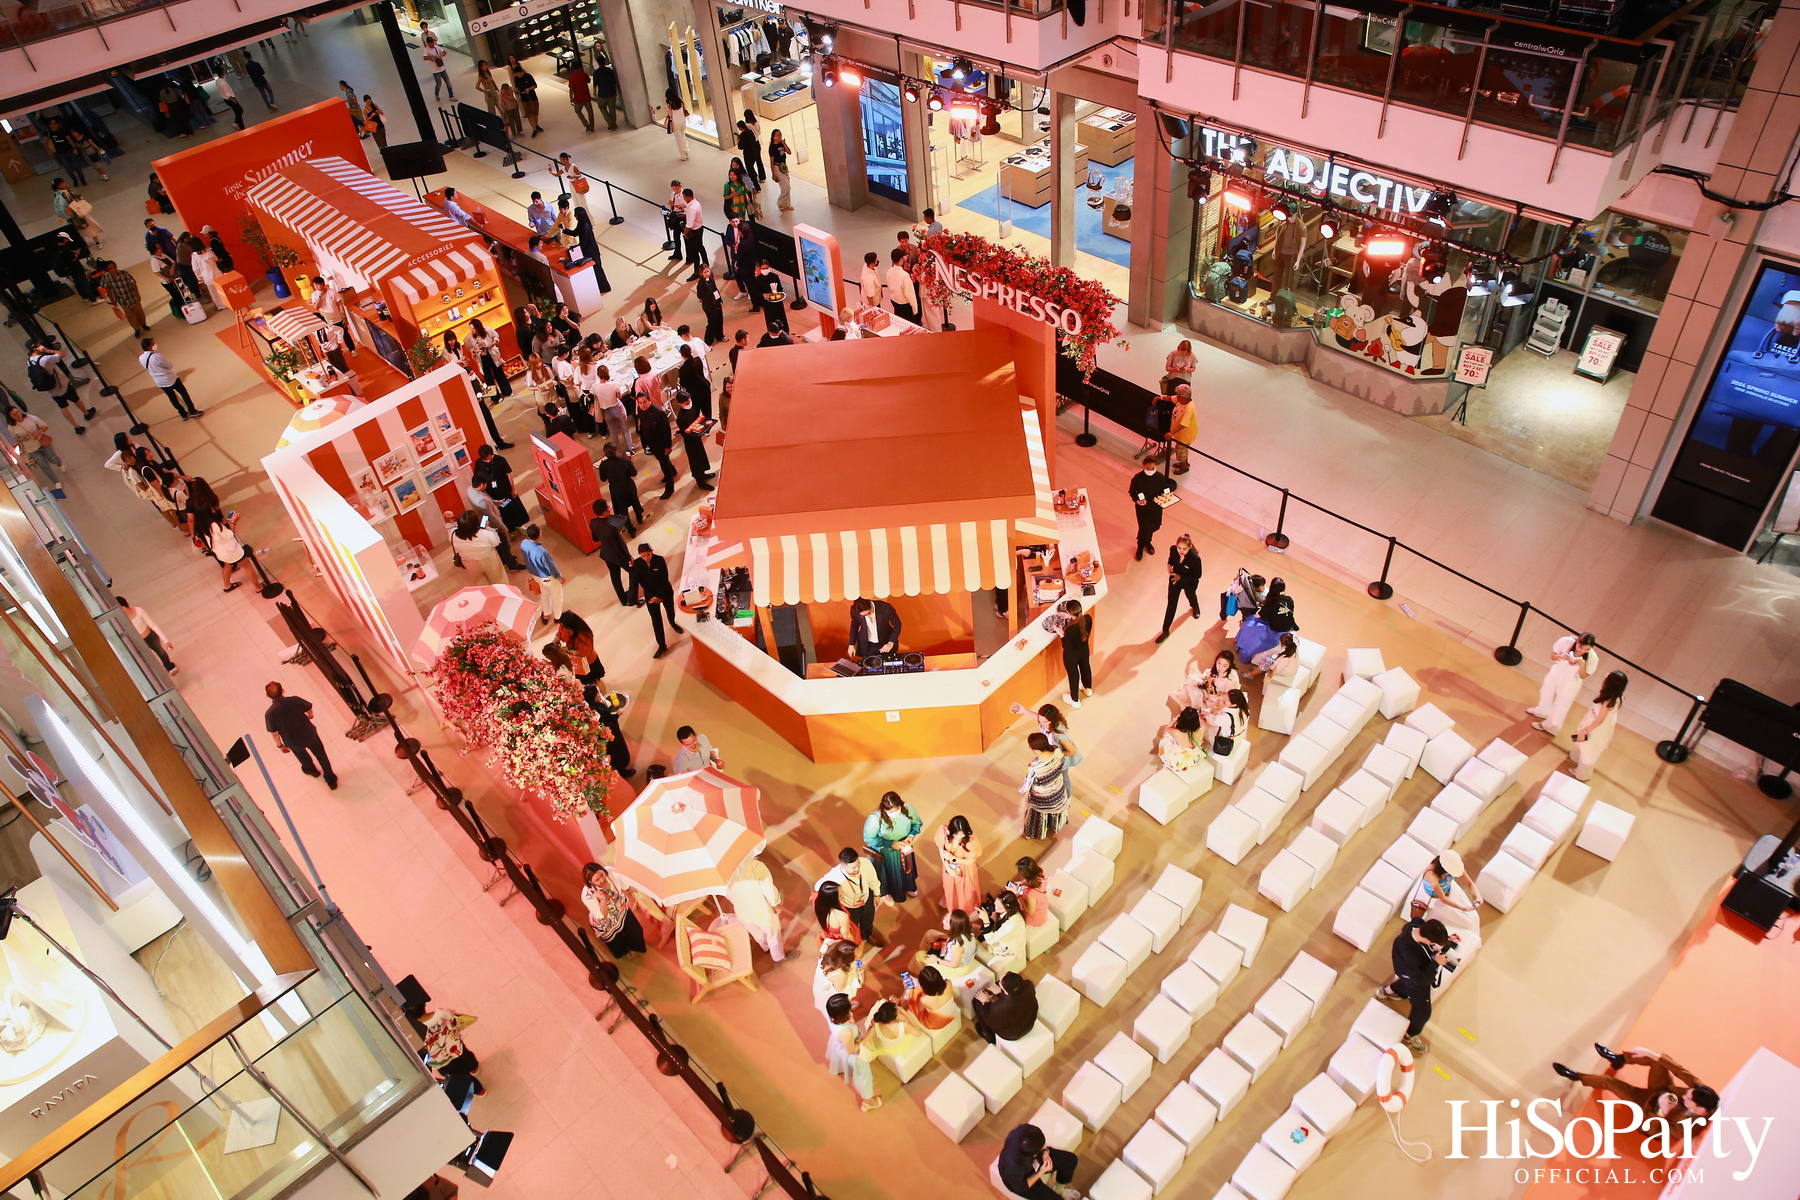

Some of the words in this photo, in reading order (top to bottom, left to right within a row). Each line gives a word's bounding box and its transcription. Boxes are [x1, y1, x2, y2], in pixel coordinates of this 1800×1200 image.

[1514, 40, 1565, 56] centralwOrld
[223, 181, 243, 196] Taste
[1266, 149, 1432, 214] ADJECTIV
[408, 243, 454, 267] ACCESSORIES
[928, 250, 1082, 336] NESPRESSO
[1593, 340, 1612, 351] SALE
[1773, 342, 1798, 354] TAKEO
[1465, 353, 1485, 363] SALE
[1588, 355, 1599, 366] 70
[1464, 369, 1475, 377] 70
[1730, 379, 1746, 388] 2024
[1769, 392, 1799, 405] SUMMER
[29, 1073, 98, 1119] RAVIPA
